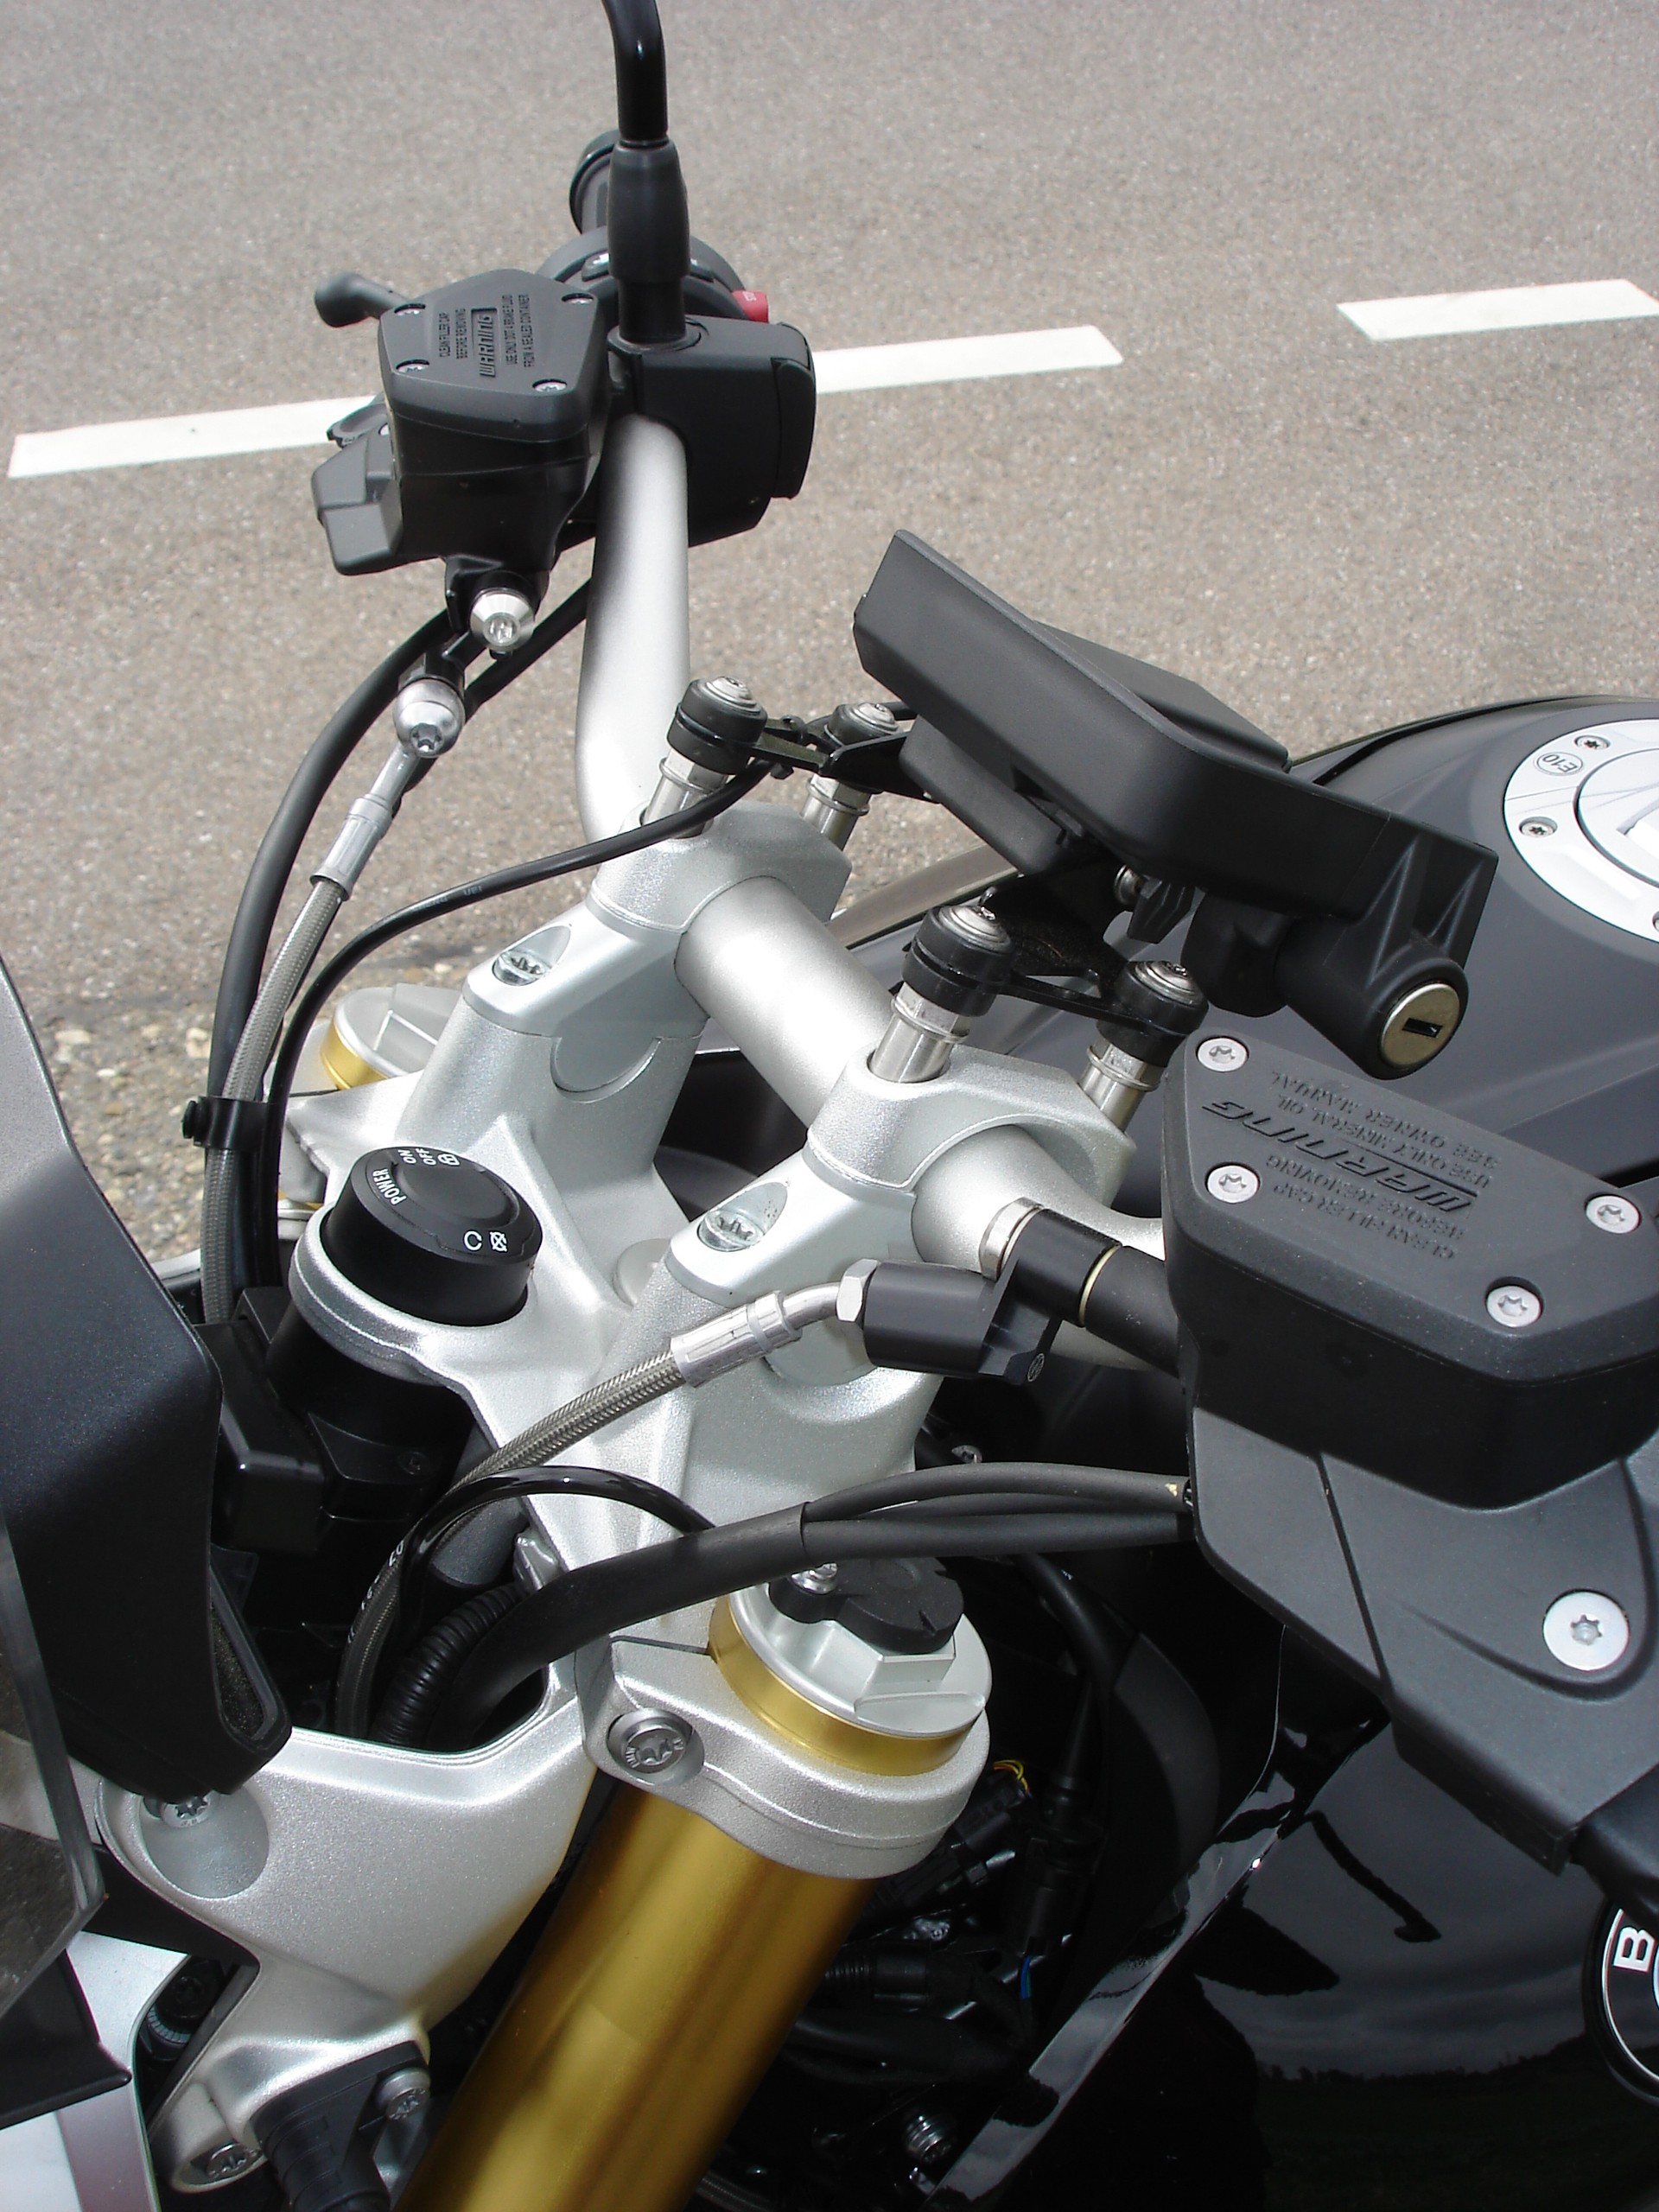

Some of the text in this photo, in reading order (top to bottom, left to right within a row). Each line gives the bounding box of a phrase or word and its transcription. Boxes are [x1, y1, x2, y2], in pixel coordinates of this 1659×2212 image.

[478, 315, 496, 378] WARNING
[1542, 753, 1578, 772] E10
[1273, 1071, 1498, 1170] SEE OWNER MANUAL
[1279, 1094, 1491, 1189] USE ONLY MINERAL OIL
[372, 1168, 407, 1205] POWER
[397, 1149, 416, 1164] ON
[416, 1147, 436, 1166] OFF
[1202, 1101, 1471, 1213] WARNING
[1266, 1154, 1464, 1241] BEFORE REMOVING
[1274, 1182, 1454, 1259] CLEAN FILLER CAP
